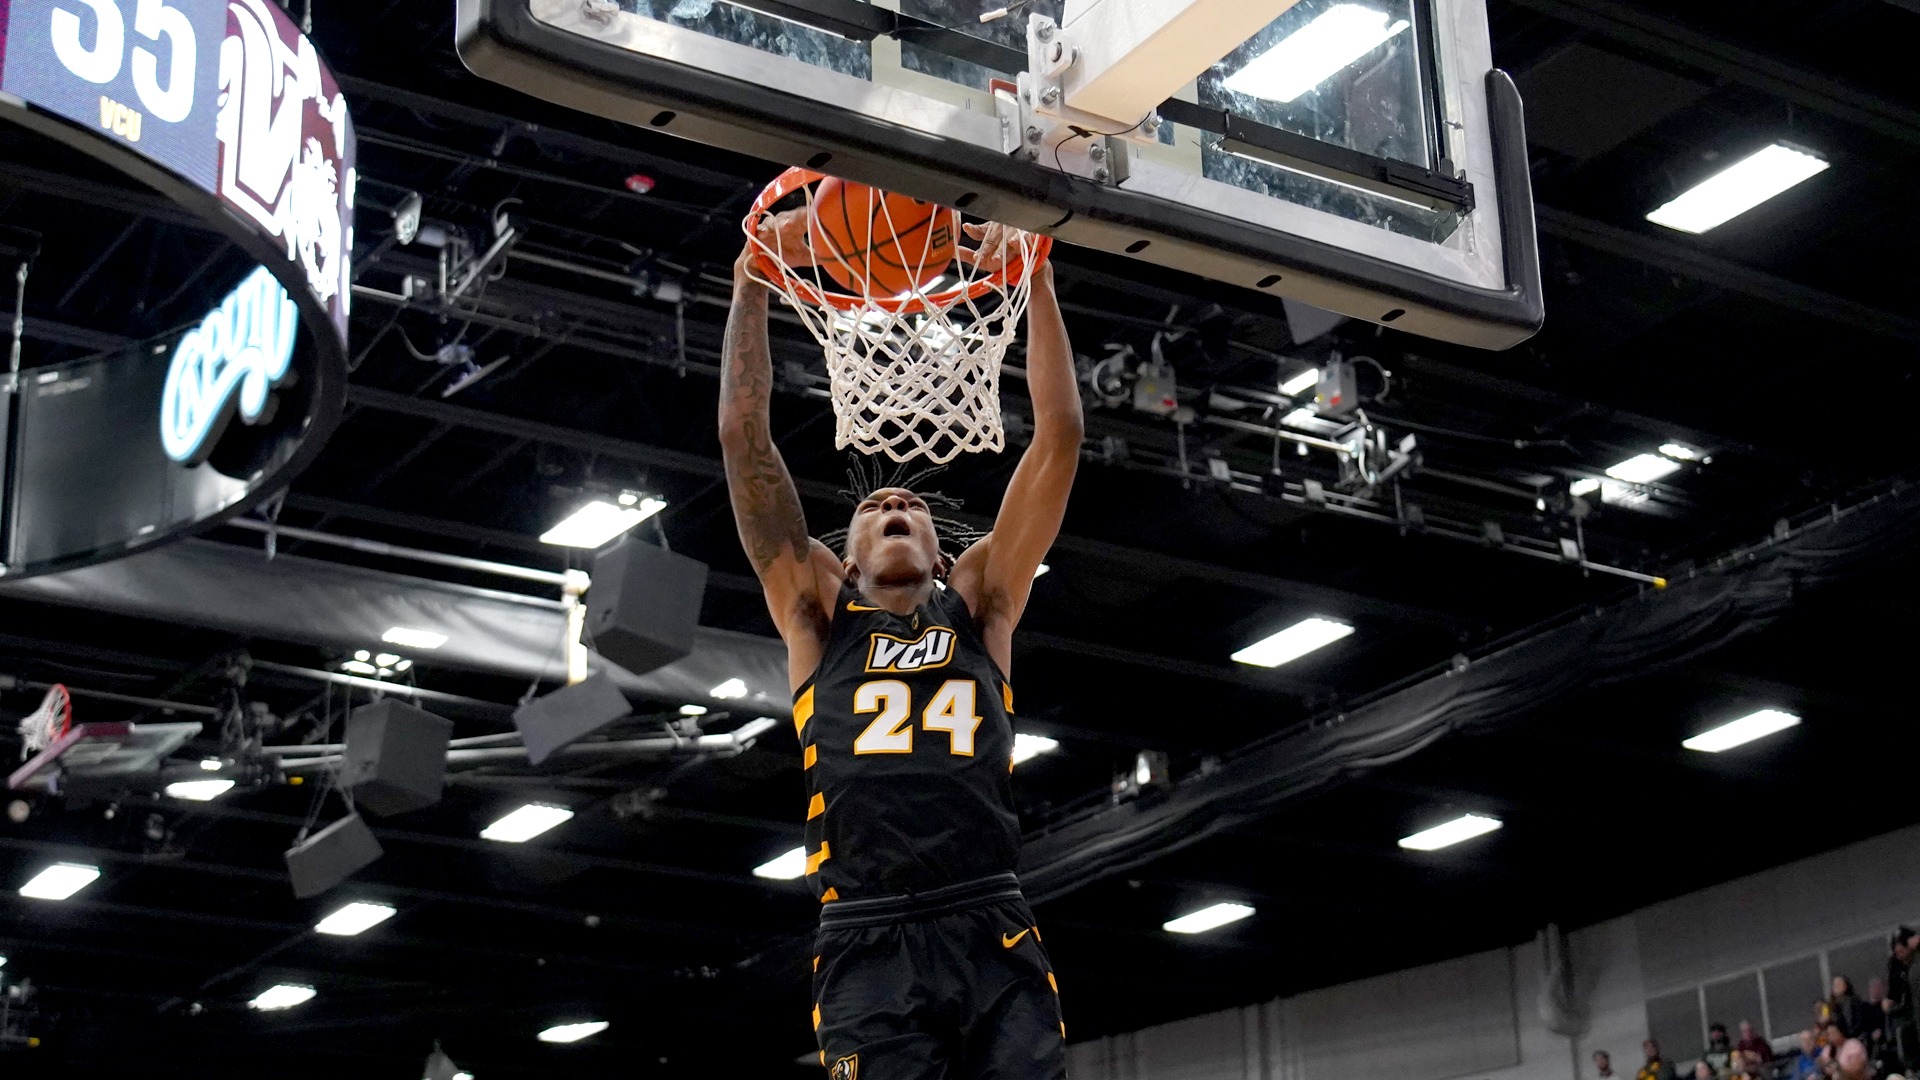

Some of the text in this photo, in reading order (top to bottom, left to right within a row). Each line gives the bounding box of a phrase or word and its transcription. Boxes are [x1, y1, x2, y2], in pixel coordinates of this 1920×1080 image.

[99, 95, 142, 142] VCU
[867, 627, 955, 671] VCU
[853, 679, 983, 757] 24
